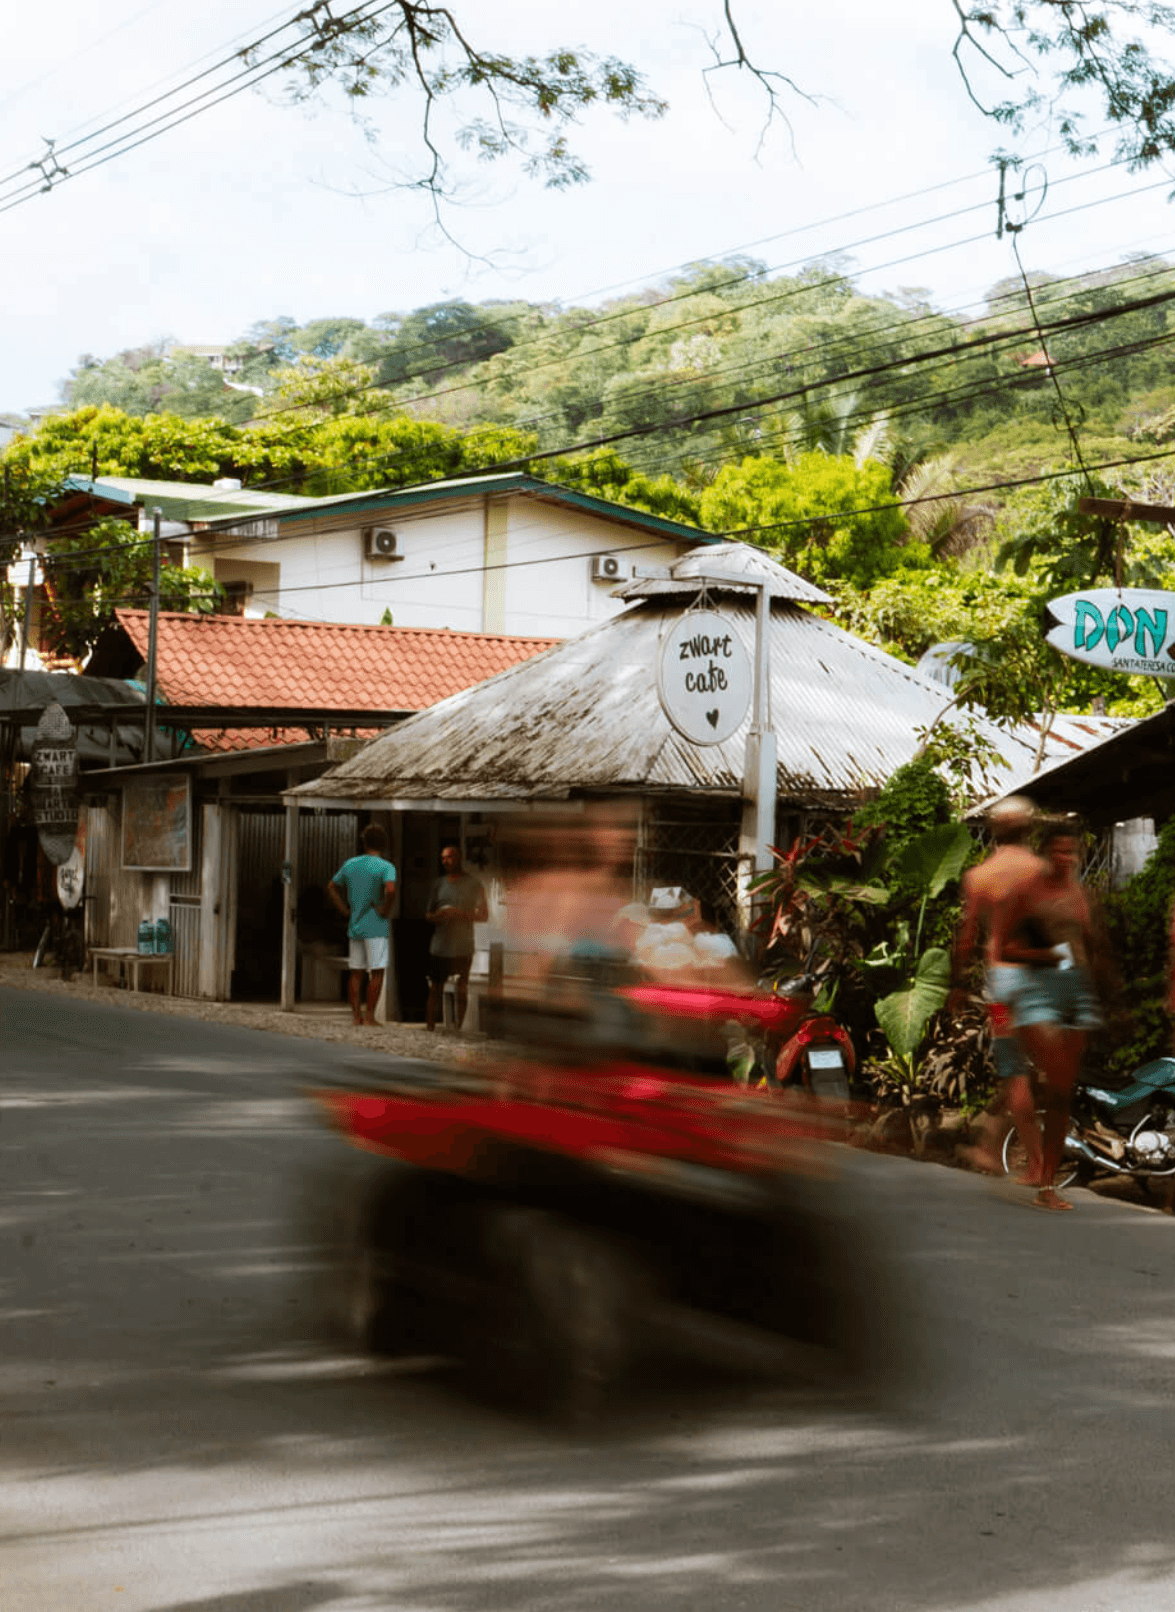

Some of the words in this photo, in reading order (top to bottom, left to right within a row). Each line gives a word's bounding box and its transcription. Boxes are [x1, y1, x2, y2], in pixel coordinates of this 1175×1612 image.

[1074, 600, 1168, 659] DON
[679, 633, 732, 660] zwart
[685, 659, 728, 693] cafe
[35, 751, 75, 762] ZWART
[40, 764, 69, 775] CAFE
